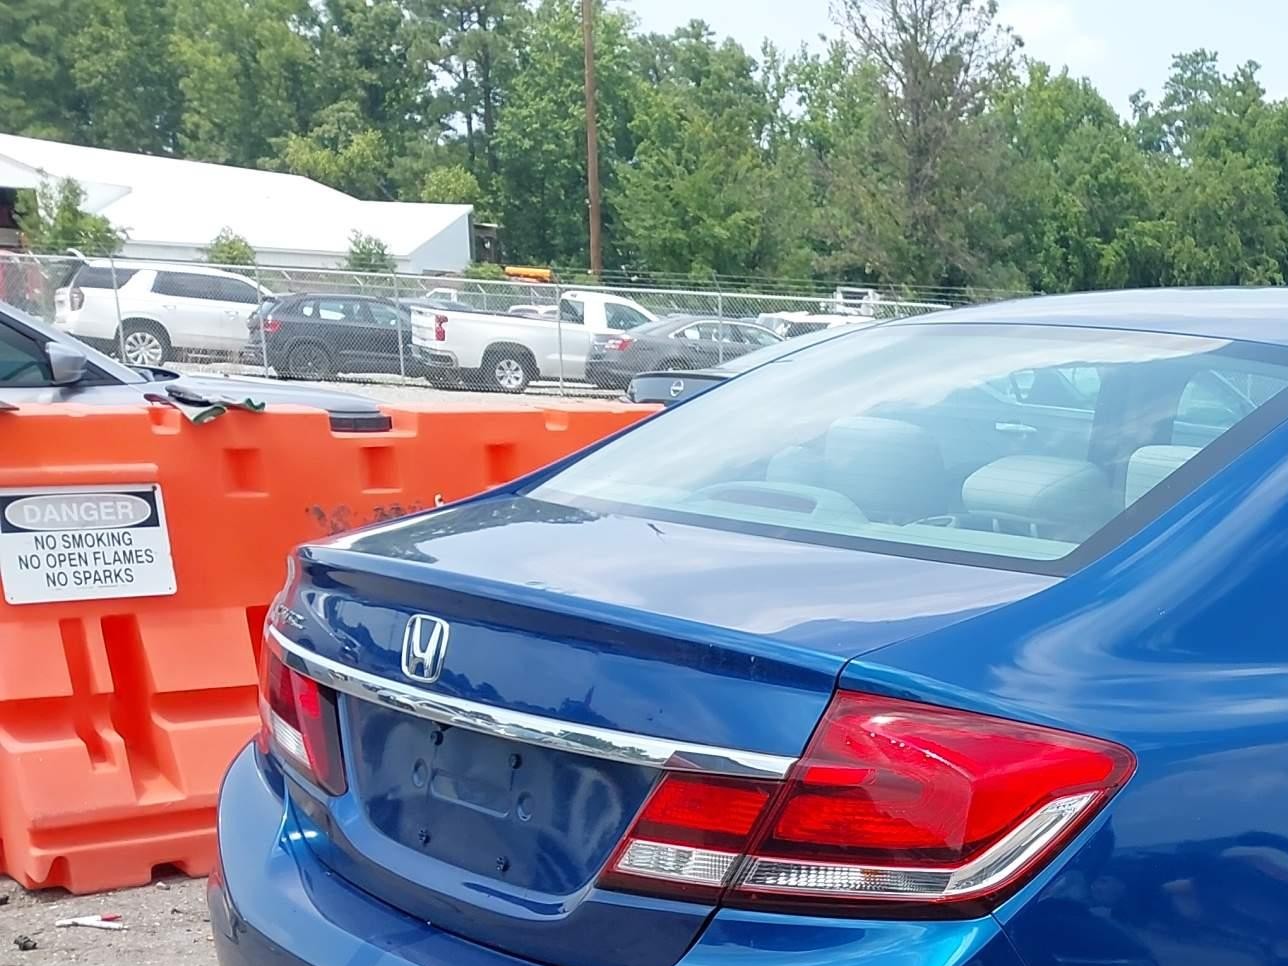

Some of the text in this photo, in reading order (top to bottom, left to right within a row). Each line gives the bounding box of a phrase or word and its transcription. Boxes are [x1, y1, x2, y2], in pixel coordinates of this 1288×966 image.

[23, 501, 134, 524] DANGER
[34, 531, 133, 550] NO SMOKING
[18, 548, 154, 570] NO OPEN FLAMES
[46, 567, 134, 587] NO SPARKS
